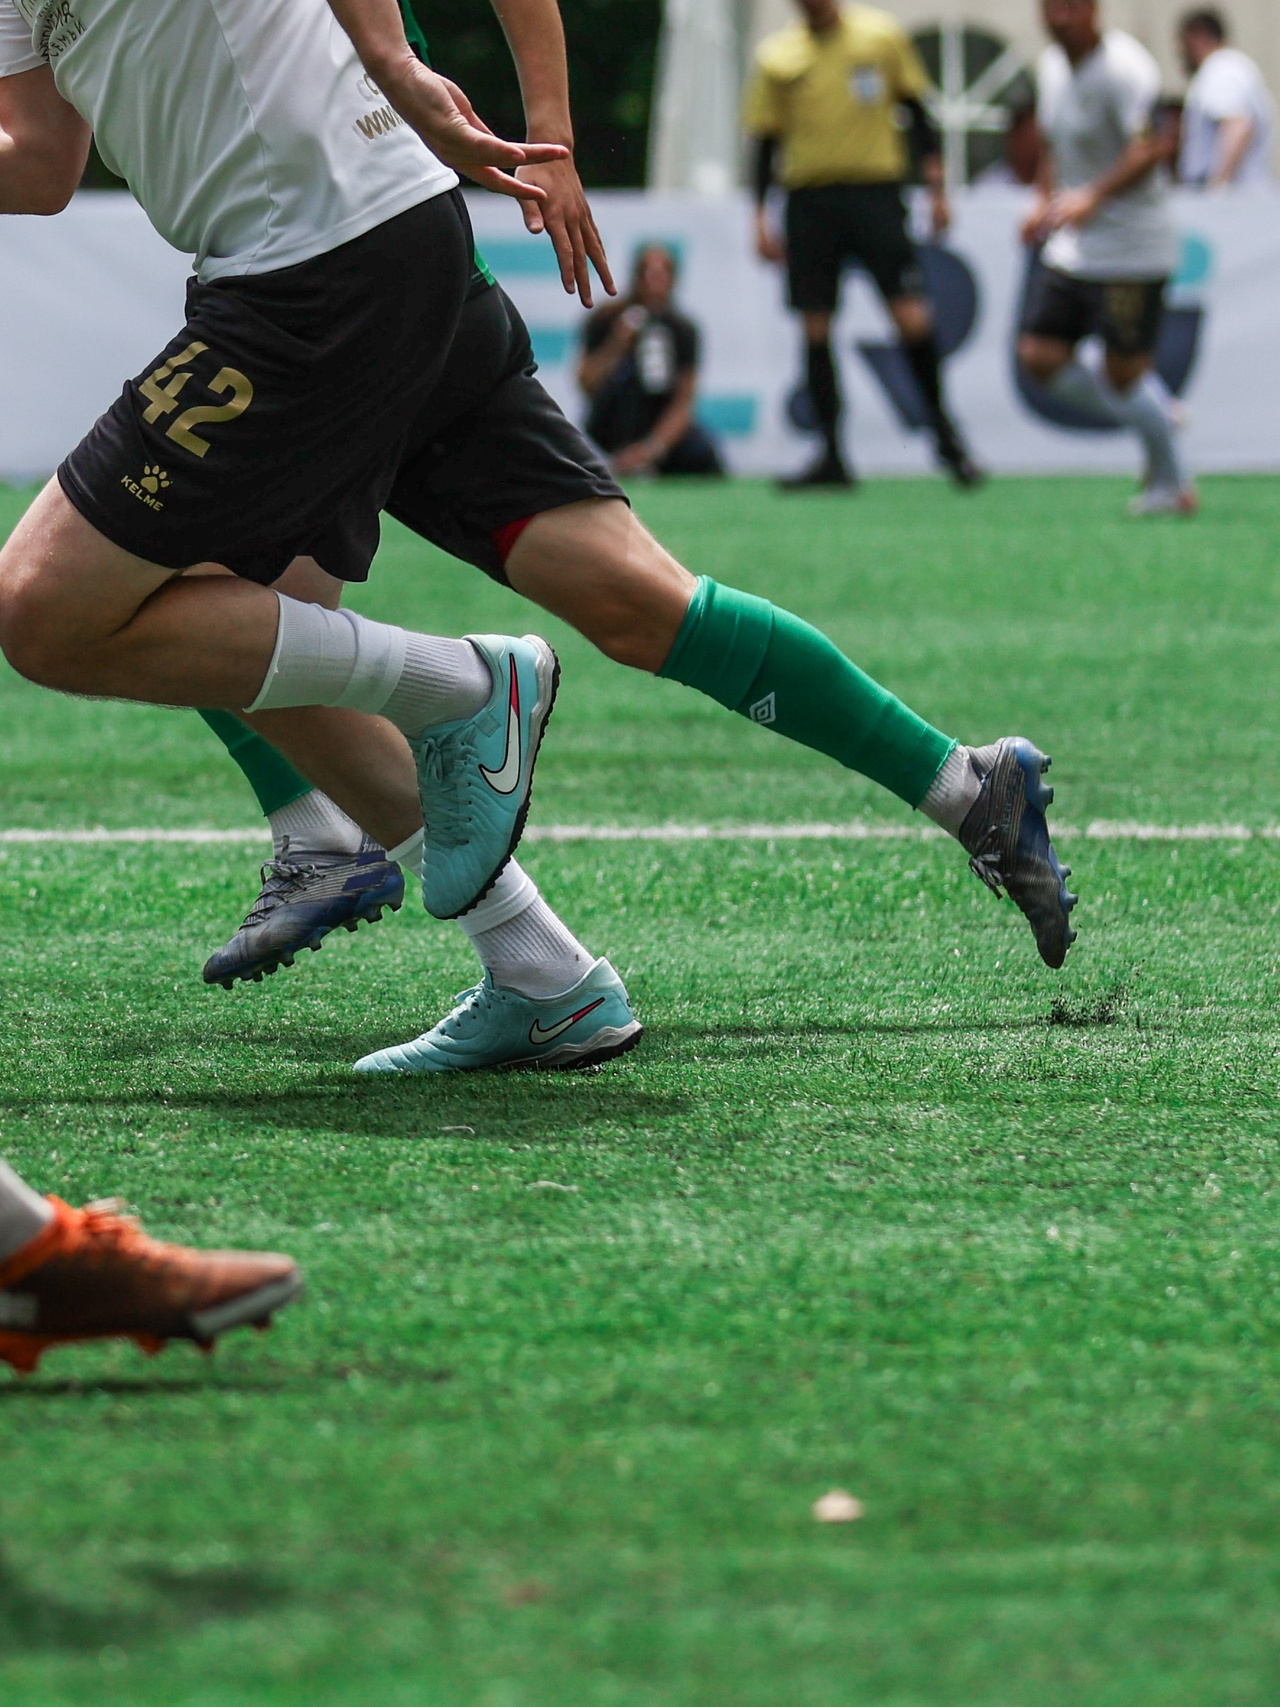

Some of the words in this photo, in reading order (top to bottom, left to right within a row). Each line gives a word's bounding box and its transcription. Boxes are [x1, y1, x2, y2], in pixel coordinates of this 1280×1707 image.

[49, 18, 87, 57] СЕМЬИ
[138, 341, 254, 458] 42
[121, 475, 164, 512] KELME
